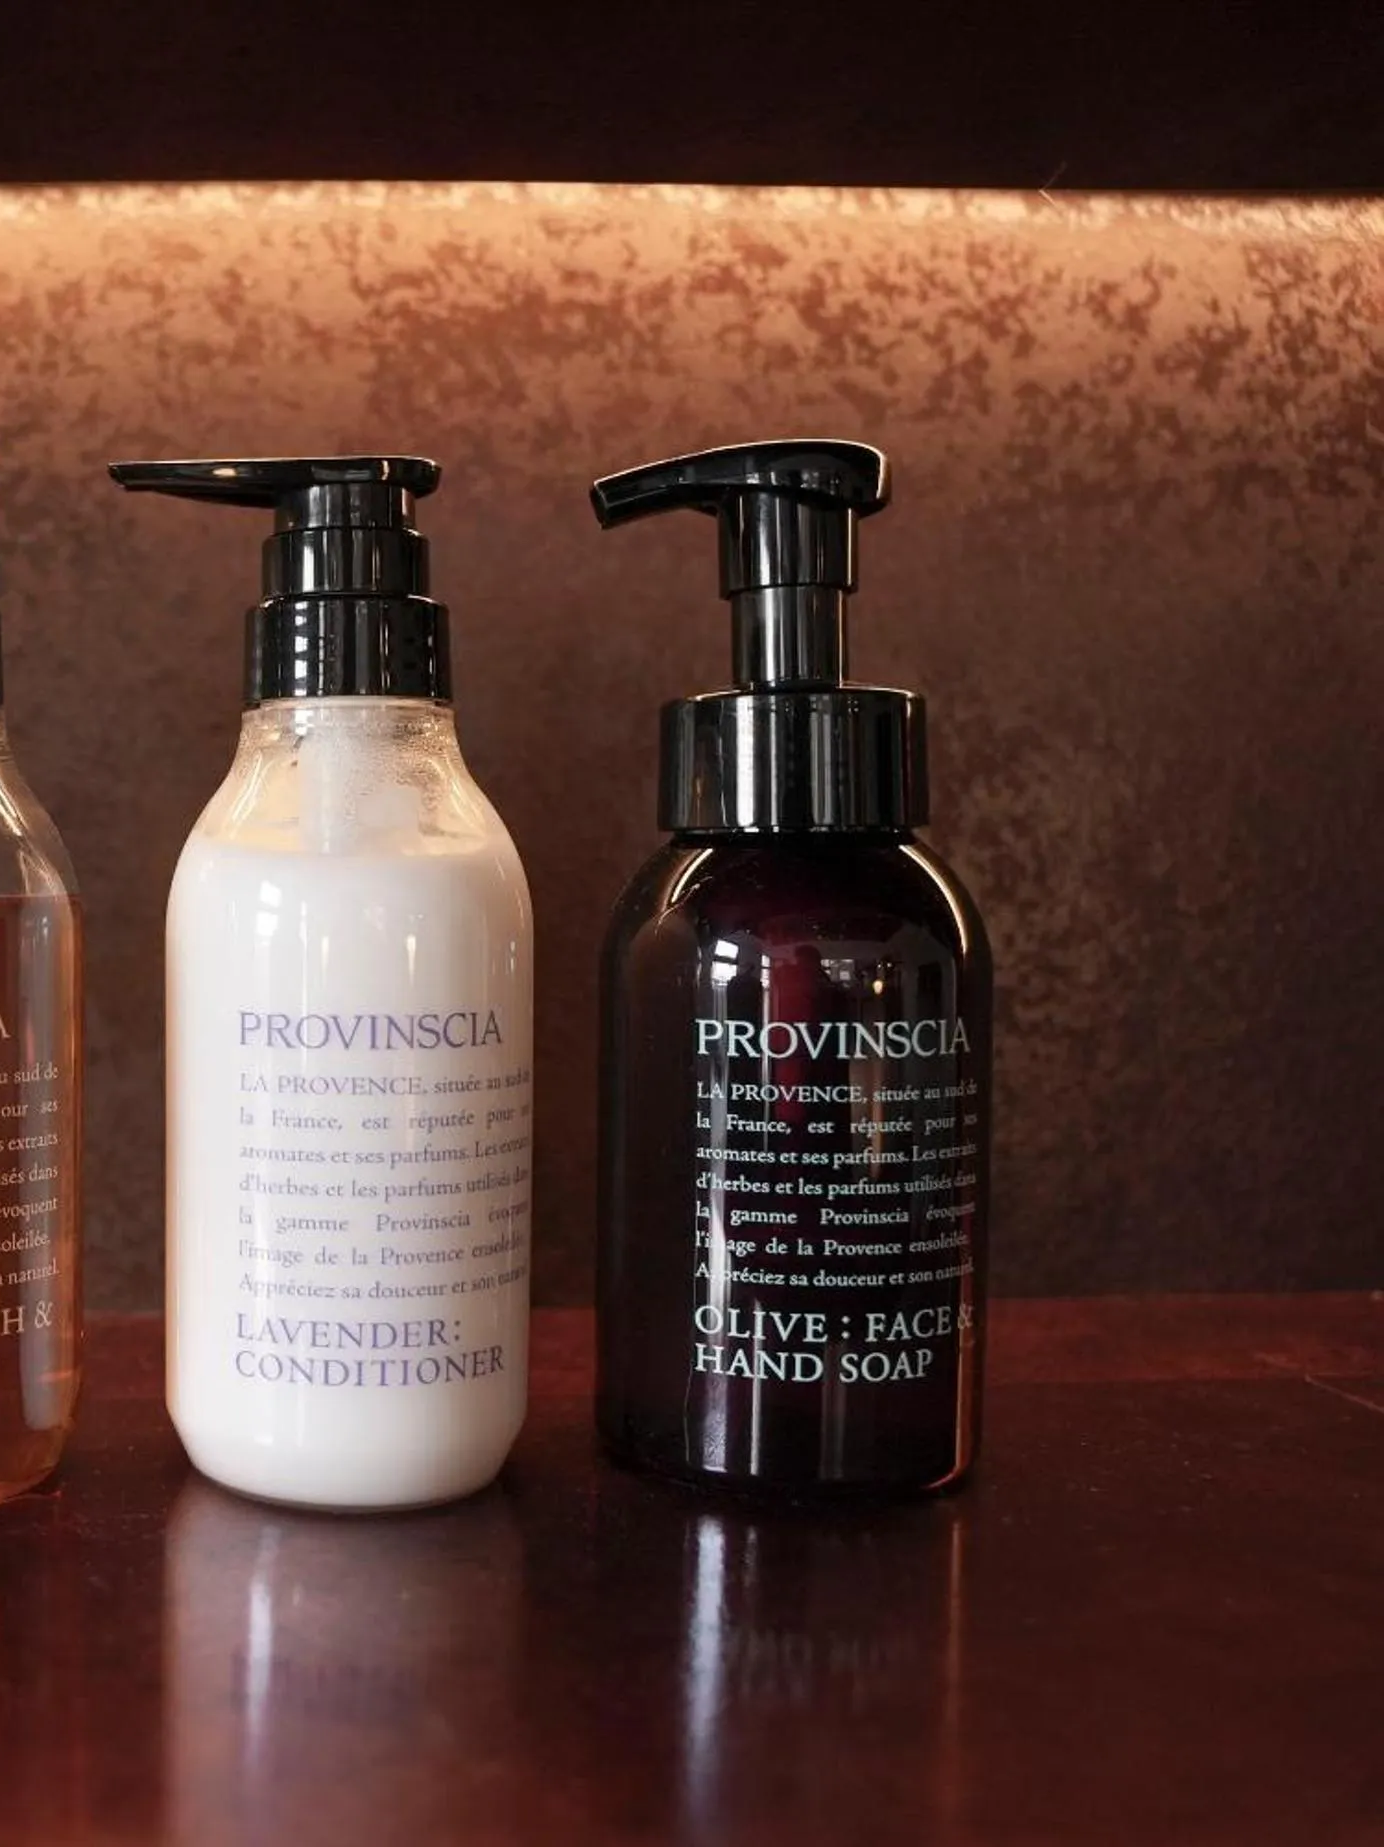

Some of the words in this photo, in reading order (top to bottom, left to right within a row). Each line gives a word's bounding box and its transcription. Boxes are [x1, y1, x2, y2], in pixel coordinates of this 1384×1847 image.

[240, 1010, 504, 1050] PROVINSCIA
[695, 1018, 971, 1060] PROVINSCIA
[14, 1064, 40, 1082] sud
[43, 1063, 58, 1080] de
[240, 1073, 267, 1092] LA
[434, 1074, 481, 1093] située
[697, 1082, 724, 1098] LA
[731, 1084, 867, 1104] PROVENCE,
[873, 1083, 920, 1100] située
[924, 1084, 941, 1099] au
[240, 1107, 254, 1126] la
[272, 1110, 342, 1129] France,
[362, 1115, 390, 1130] est
[410, 1110, 475, 1135] réputée
[697, 1112, 710, 1128] la
[727, 1114, 791, 1134] France,
[808, 1121, 834, 1134] est
[850, 1115, 912, 1136] réputée
[924, 1115, 955, 1135] pour
[8, 1132, 58, 1151] extraits
[240, 1145, 325, 1164] aromates
[331, 1148, 349, 1164] et
[355, 1150, 384, 1164] ses
[391, 1146, 469, 1169] parfums.
[697, 1146, 775, 1162] aromates
[780, 1149, 797, 1163] et
[802, 1151, 828, 1164] ses
[833, 1147, 909, 1169] parfums.
[912, 1145, 936, 1162] Les
[29, 1163, 58, 1182] dans
[240, 1174, 318, 1196] d'herbes
[326, 1182, 344, 1196] et
[351, 1175, 377, 1198] les
[385, 1175, 462, 1201] parfums
[697, 1174, 769, 1194] d'herbes
[775, 1180, 792, 1193] et
[799, 1178, 822, 1195] les
[828, 1177, 900, 1199] parfums
[905, 1173, 952, 1191] utilisés
[240, 1206, 252, 1225] la
[275, 1215, 349, 1233] gamme
[377, 1213, 471, 1232] Provinscia
[697, 1202, 709, 1217] la
[730, 1210, 798, 1226] gamme
[820, 1207, 909, 1224] Provinscia
[240, 1239, 303, 1264] l'image
[315, 1244, 338, 1265] de
[352, 1242, 368, 1266] la
[381, 1245, 464, 1266] Provence
[765, 1238, 787, 1254] de
[798, 1239, 813, 1256] la
[823, 1239, 902, 1255] Provence
[8, 1260, 59, 1284] naturel.
[240, 1272, 334, 1297] Appréciez
[340, 1284, 360, 1298] sa
[368, 1281, 447, 1298] douceur
[452, 1278, 467, 1294] et
[790, 1273, 808, 1285] sa
[813, 1268, 885, 1287] douceur
[889, 1271, 905, 1285] et
[908, 1269, 933, 1284] son
[34, 1301, 53, 1327] &
[695, 1306, 827, 1343] OLIVE
[865, 1306, 952, 1342] FACE
[957, 1304, 973, 1329] &
[236, 1313, 462, 1349] LAVENDER:
[235, 1345, 504, 1386] CONDITIONER
[695, 1344, 824, 1382] HAND
[840, 1348, 933, 1383] SOAP
